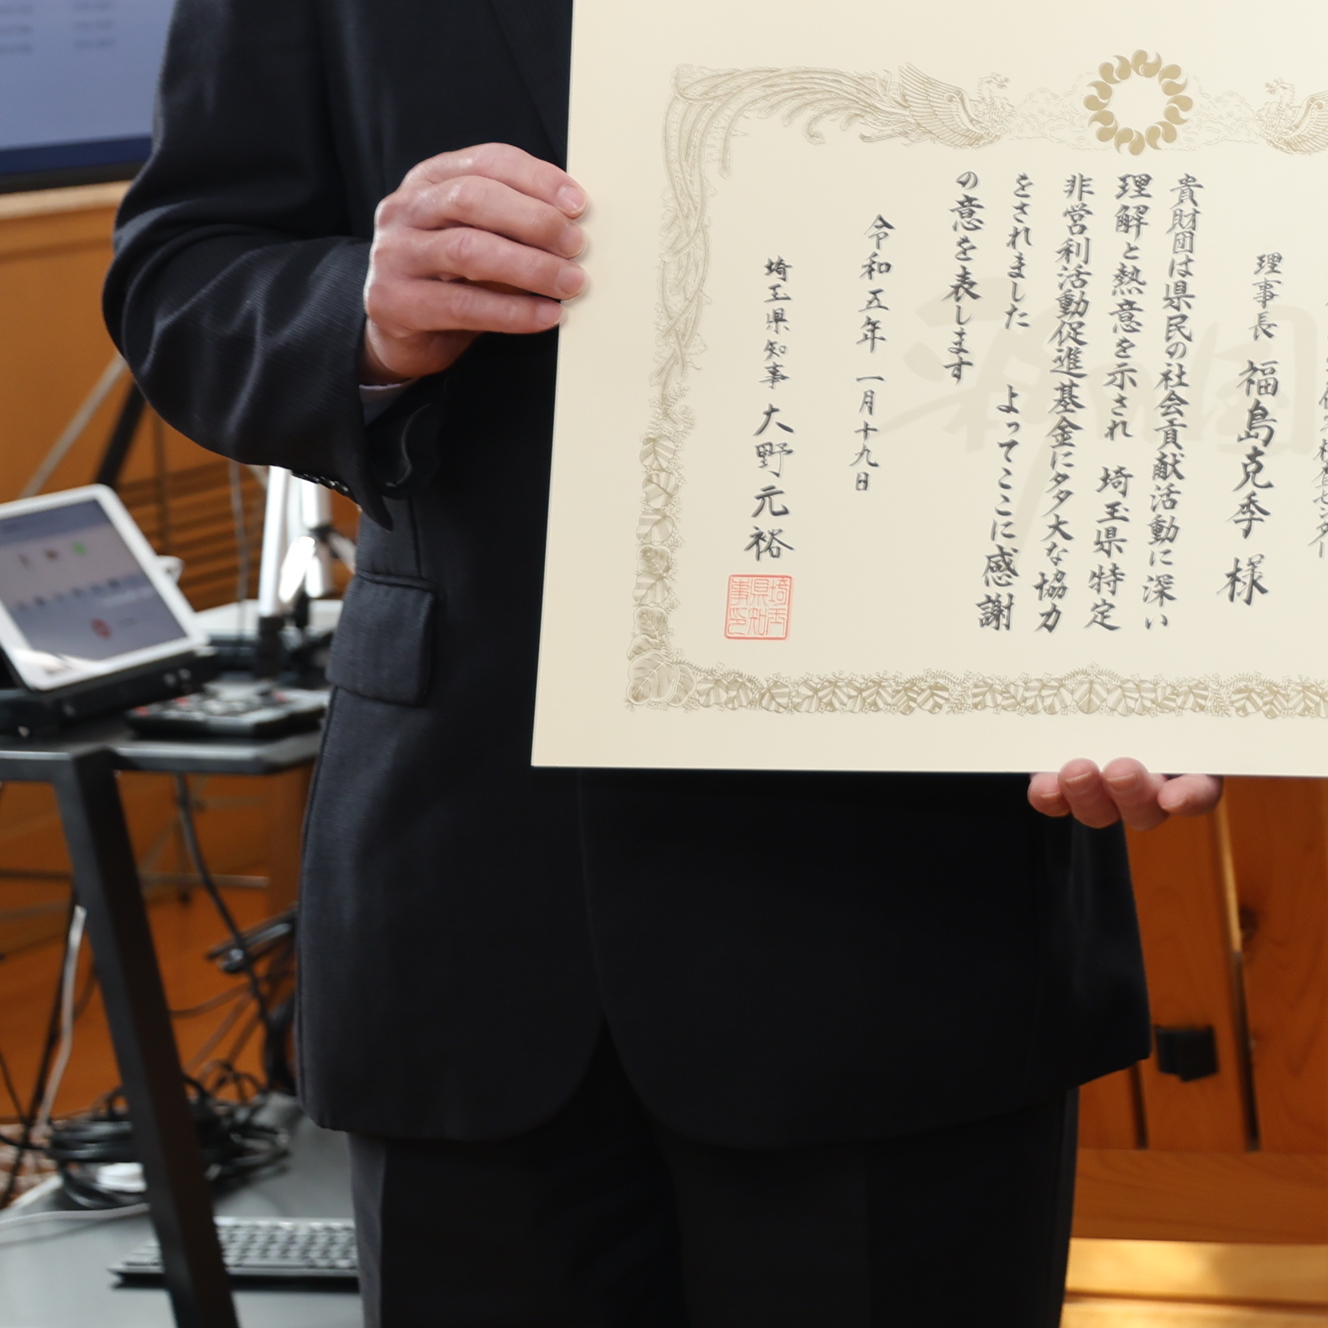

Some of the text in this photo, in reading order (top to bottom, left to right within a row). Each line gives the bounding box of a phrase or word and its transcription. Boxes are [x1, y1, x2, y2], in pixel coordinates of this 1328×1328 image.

[743, 255, 796, 563] 埼玉県知事 大野元裕
[848, 213, 897, 493] 令和五年 一月十九日
[941, 170, 984, 386] の意を表します
[974, 171, 1035, 633] をされました よってここに感謝
[1032, 172, 1095, 635] 非営利活動促進基金に多大な協力
[1084, 172, 1153, 633] 理解と熱意を示され 埼玉県特定
[1142, 172, 1204, 632] 貴財団は県民の社会貢献活動に深い
[1216, 251, 1284, 608] 理事長 福島克季 様
